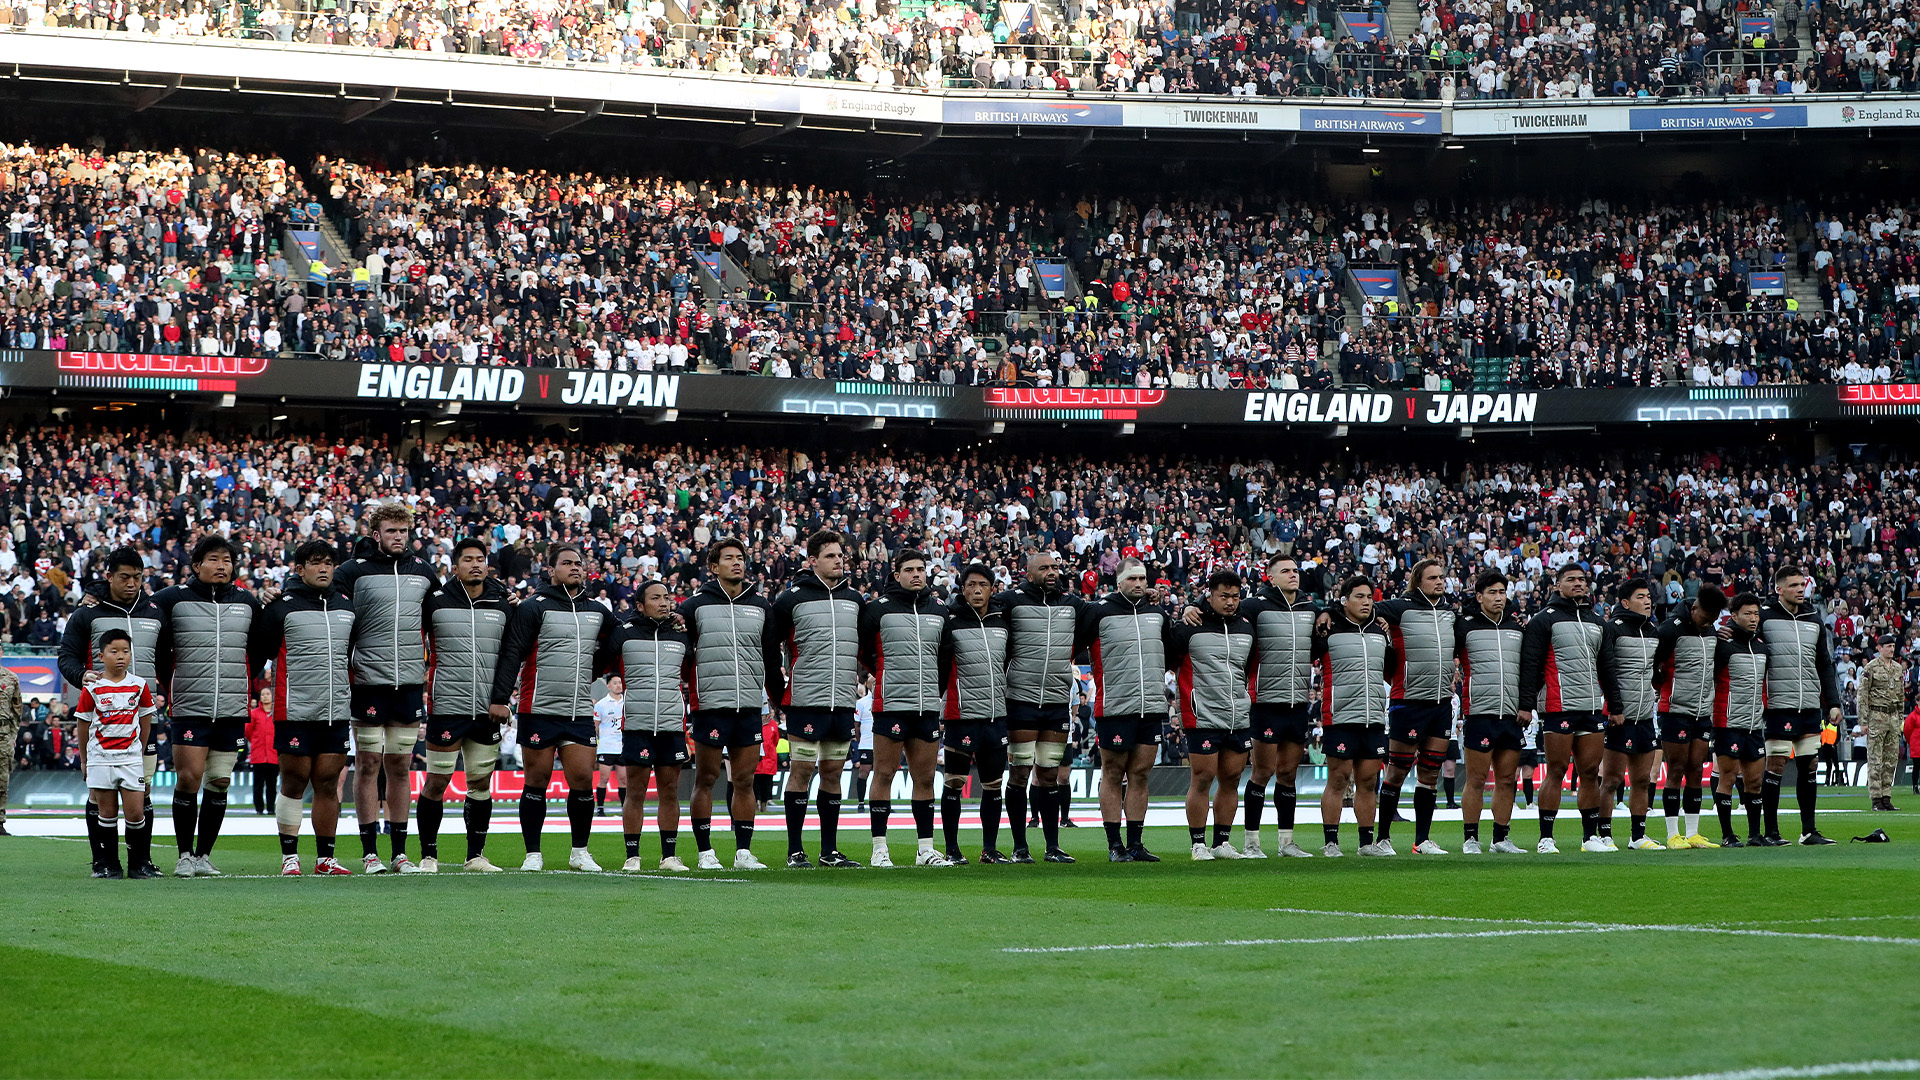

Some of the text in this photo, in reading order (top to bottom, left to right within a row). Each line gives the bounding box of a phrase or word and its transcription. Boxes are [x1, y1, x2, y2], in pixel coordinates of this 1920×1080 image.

[841, 99, 916, 116] England Rugby
[974, 111, 1069, 123] BRITISH AIRWAYS
[1183, 109, 1259, 124] TWICKENHAM
[1511, 114, 1588, 128] TWICKENHAM
[1661, 116, 1754, 128] BRITISH AIRWAYS
[1858, 108, 1903, 122] England
[1314, 119, 1405, 131] BRITISH AIRWAYS
[357, 363, 680, 407] ENGLAND V JAPAN
[1243, 392, 1537, 424] ENGLAND V JAPAN
